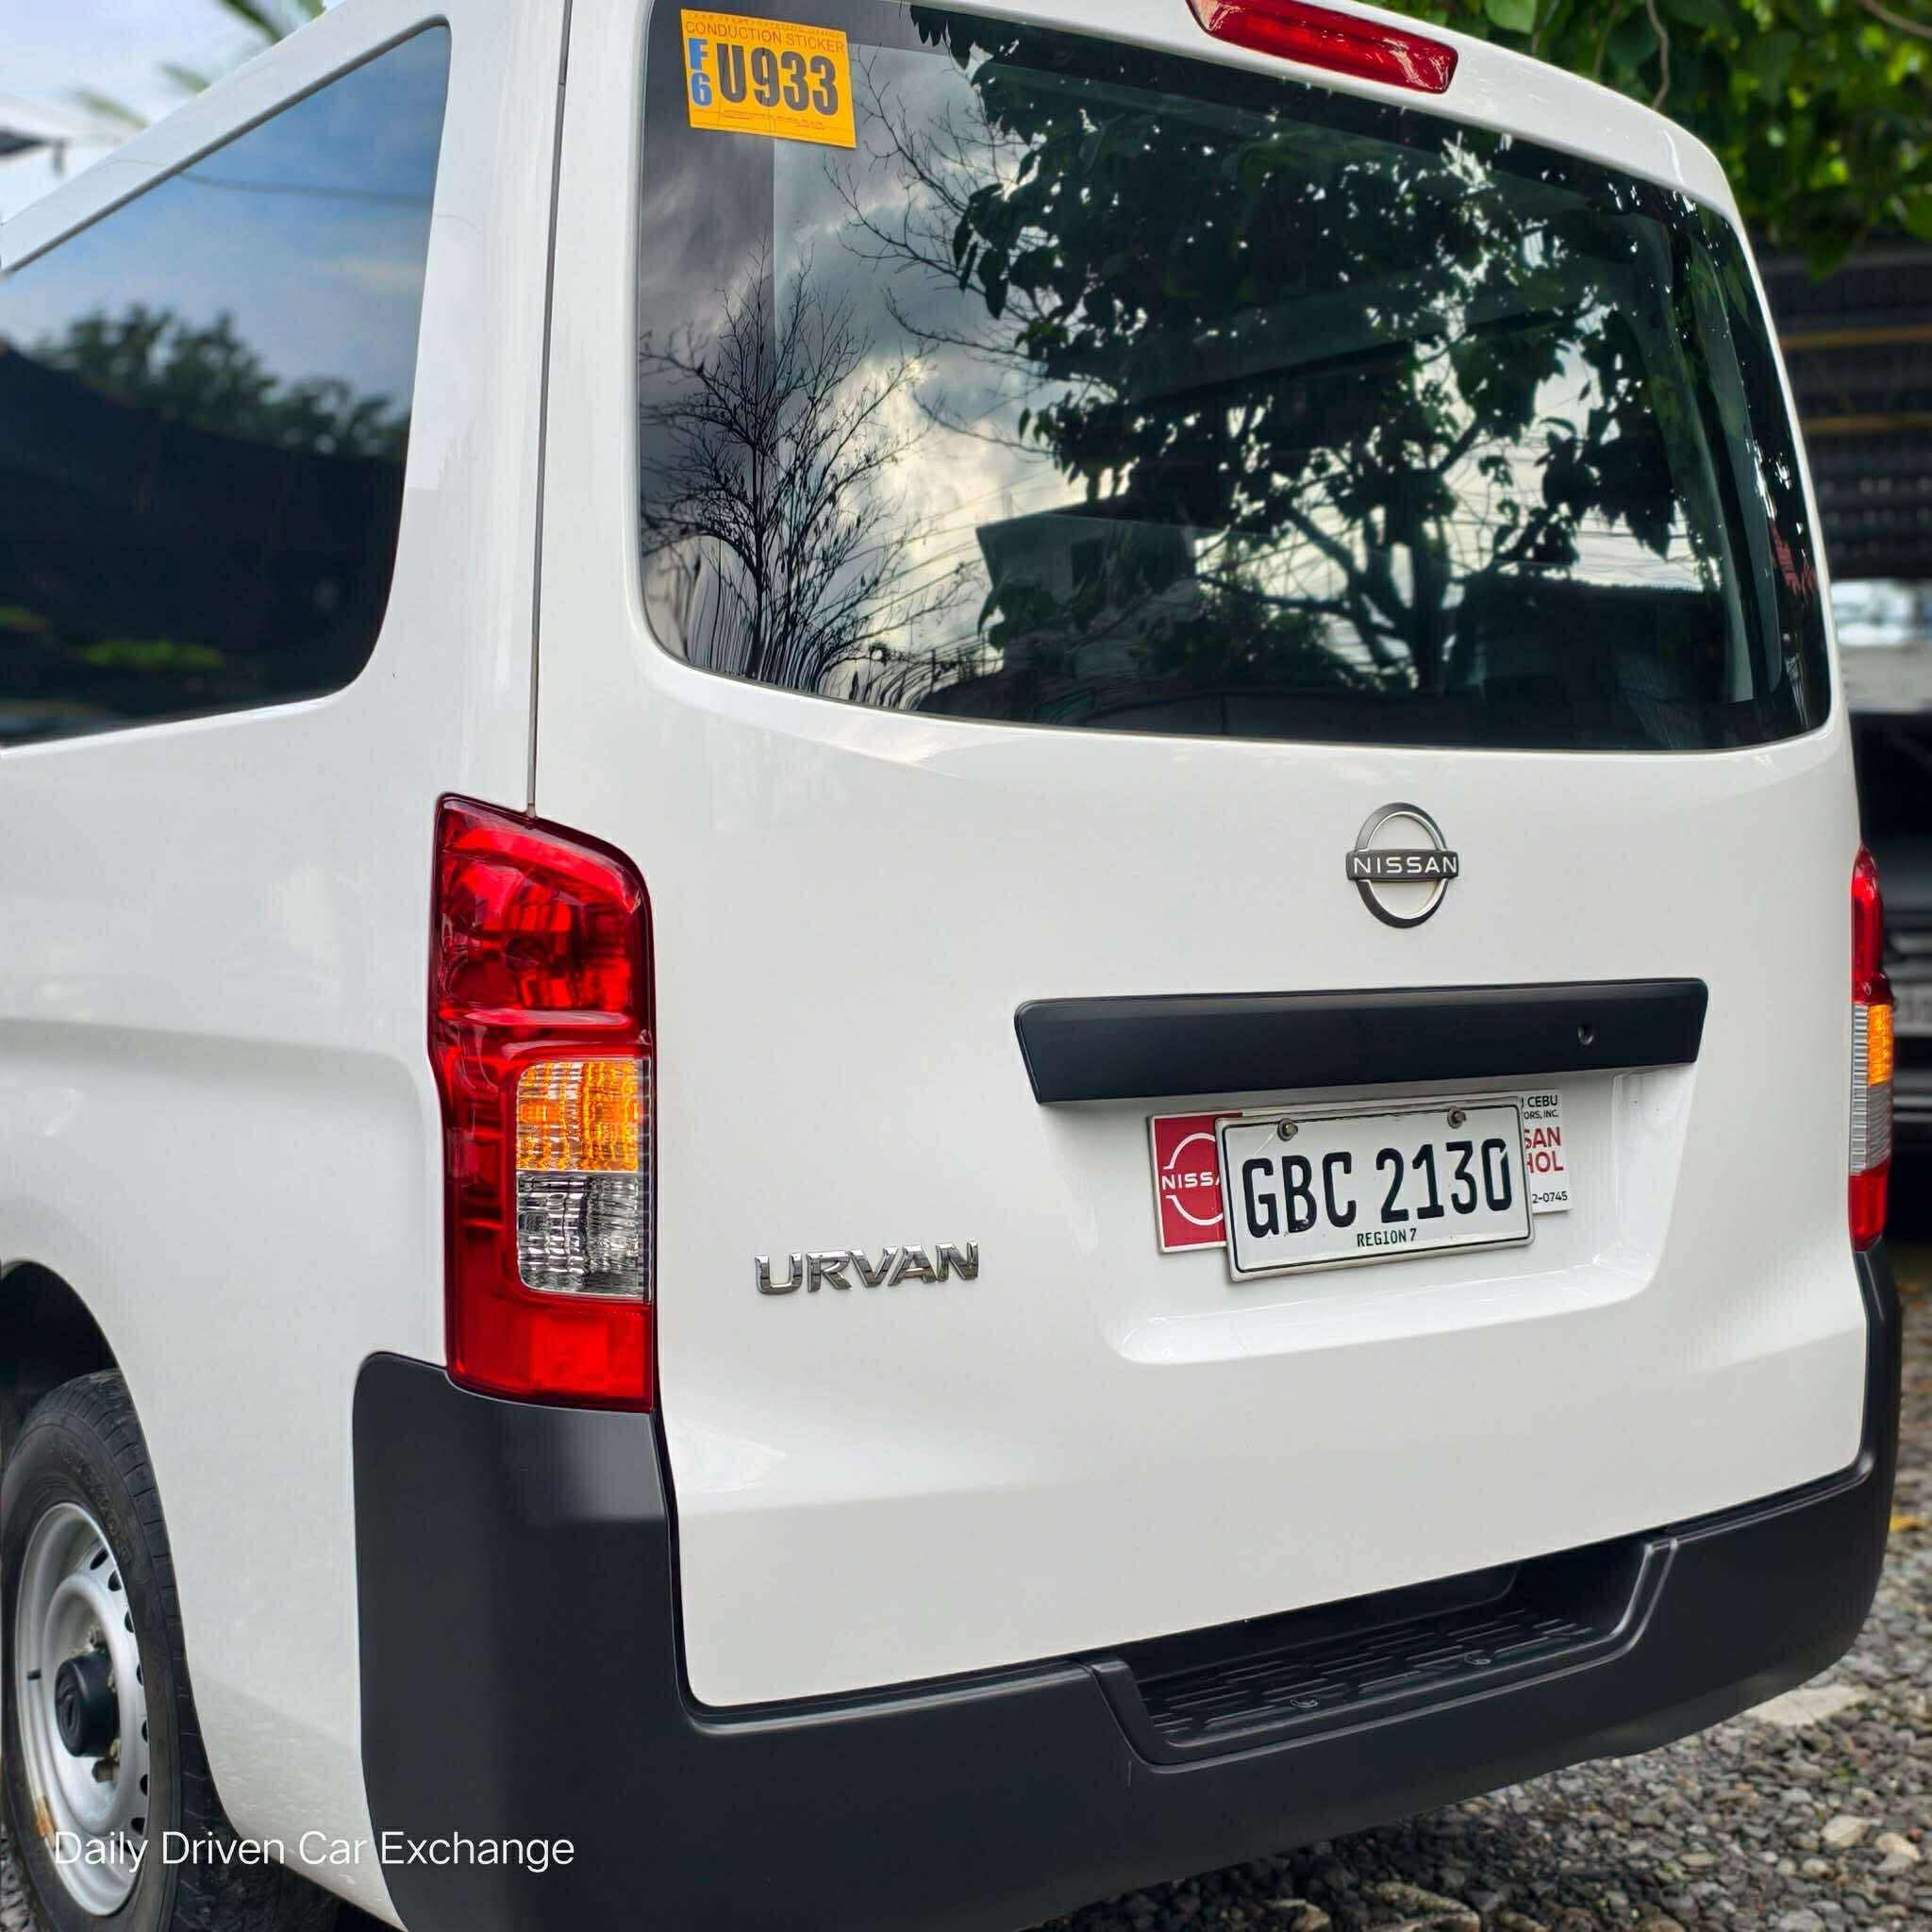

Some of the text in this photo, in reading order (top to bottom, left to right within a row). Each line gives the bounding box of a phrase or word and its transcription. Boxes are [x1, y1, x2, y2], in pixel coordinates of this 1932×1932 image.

[686, 21, 782, 44] CONDUCTION
[786, 33, 846, 54] STICKER
[716, 42, 839, 116] U933
[1354, 857, 1457, 874] NISSAN
[1527, 1094, 1558, 1108] CEBU
[1241, 1138, 1512, 1239] GBC 2130
[1357, 1227, 1417, 1247] REGION 7
[755, 1237, 979, 1295] URVAN
